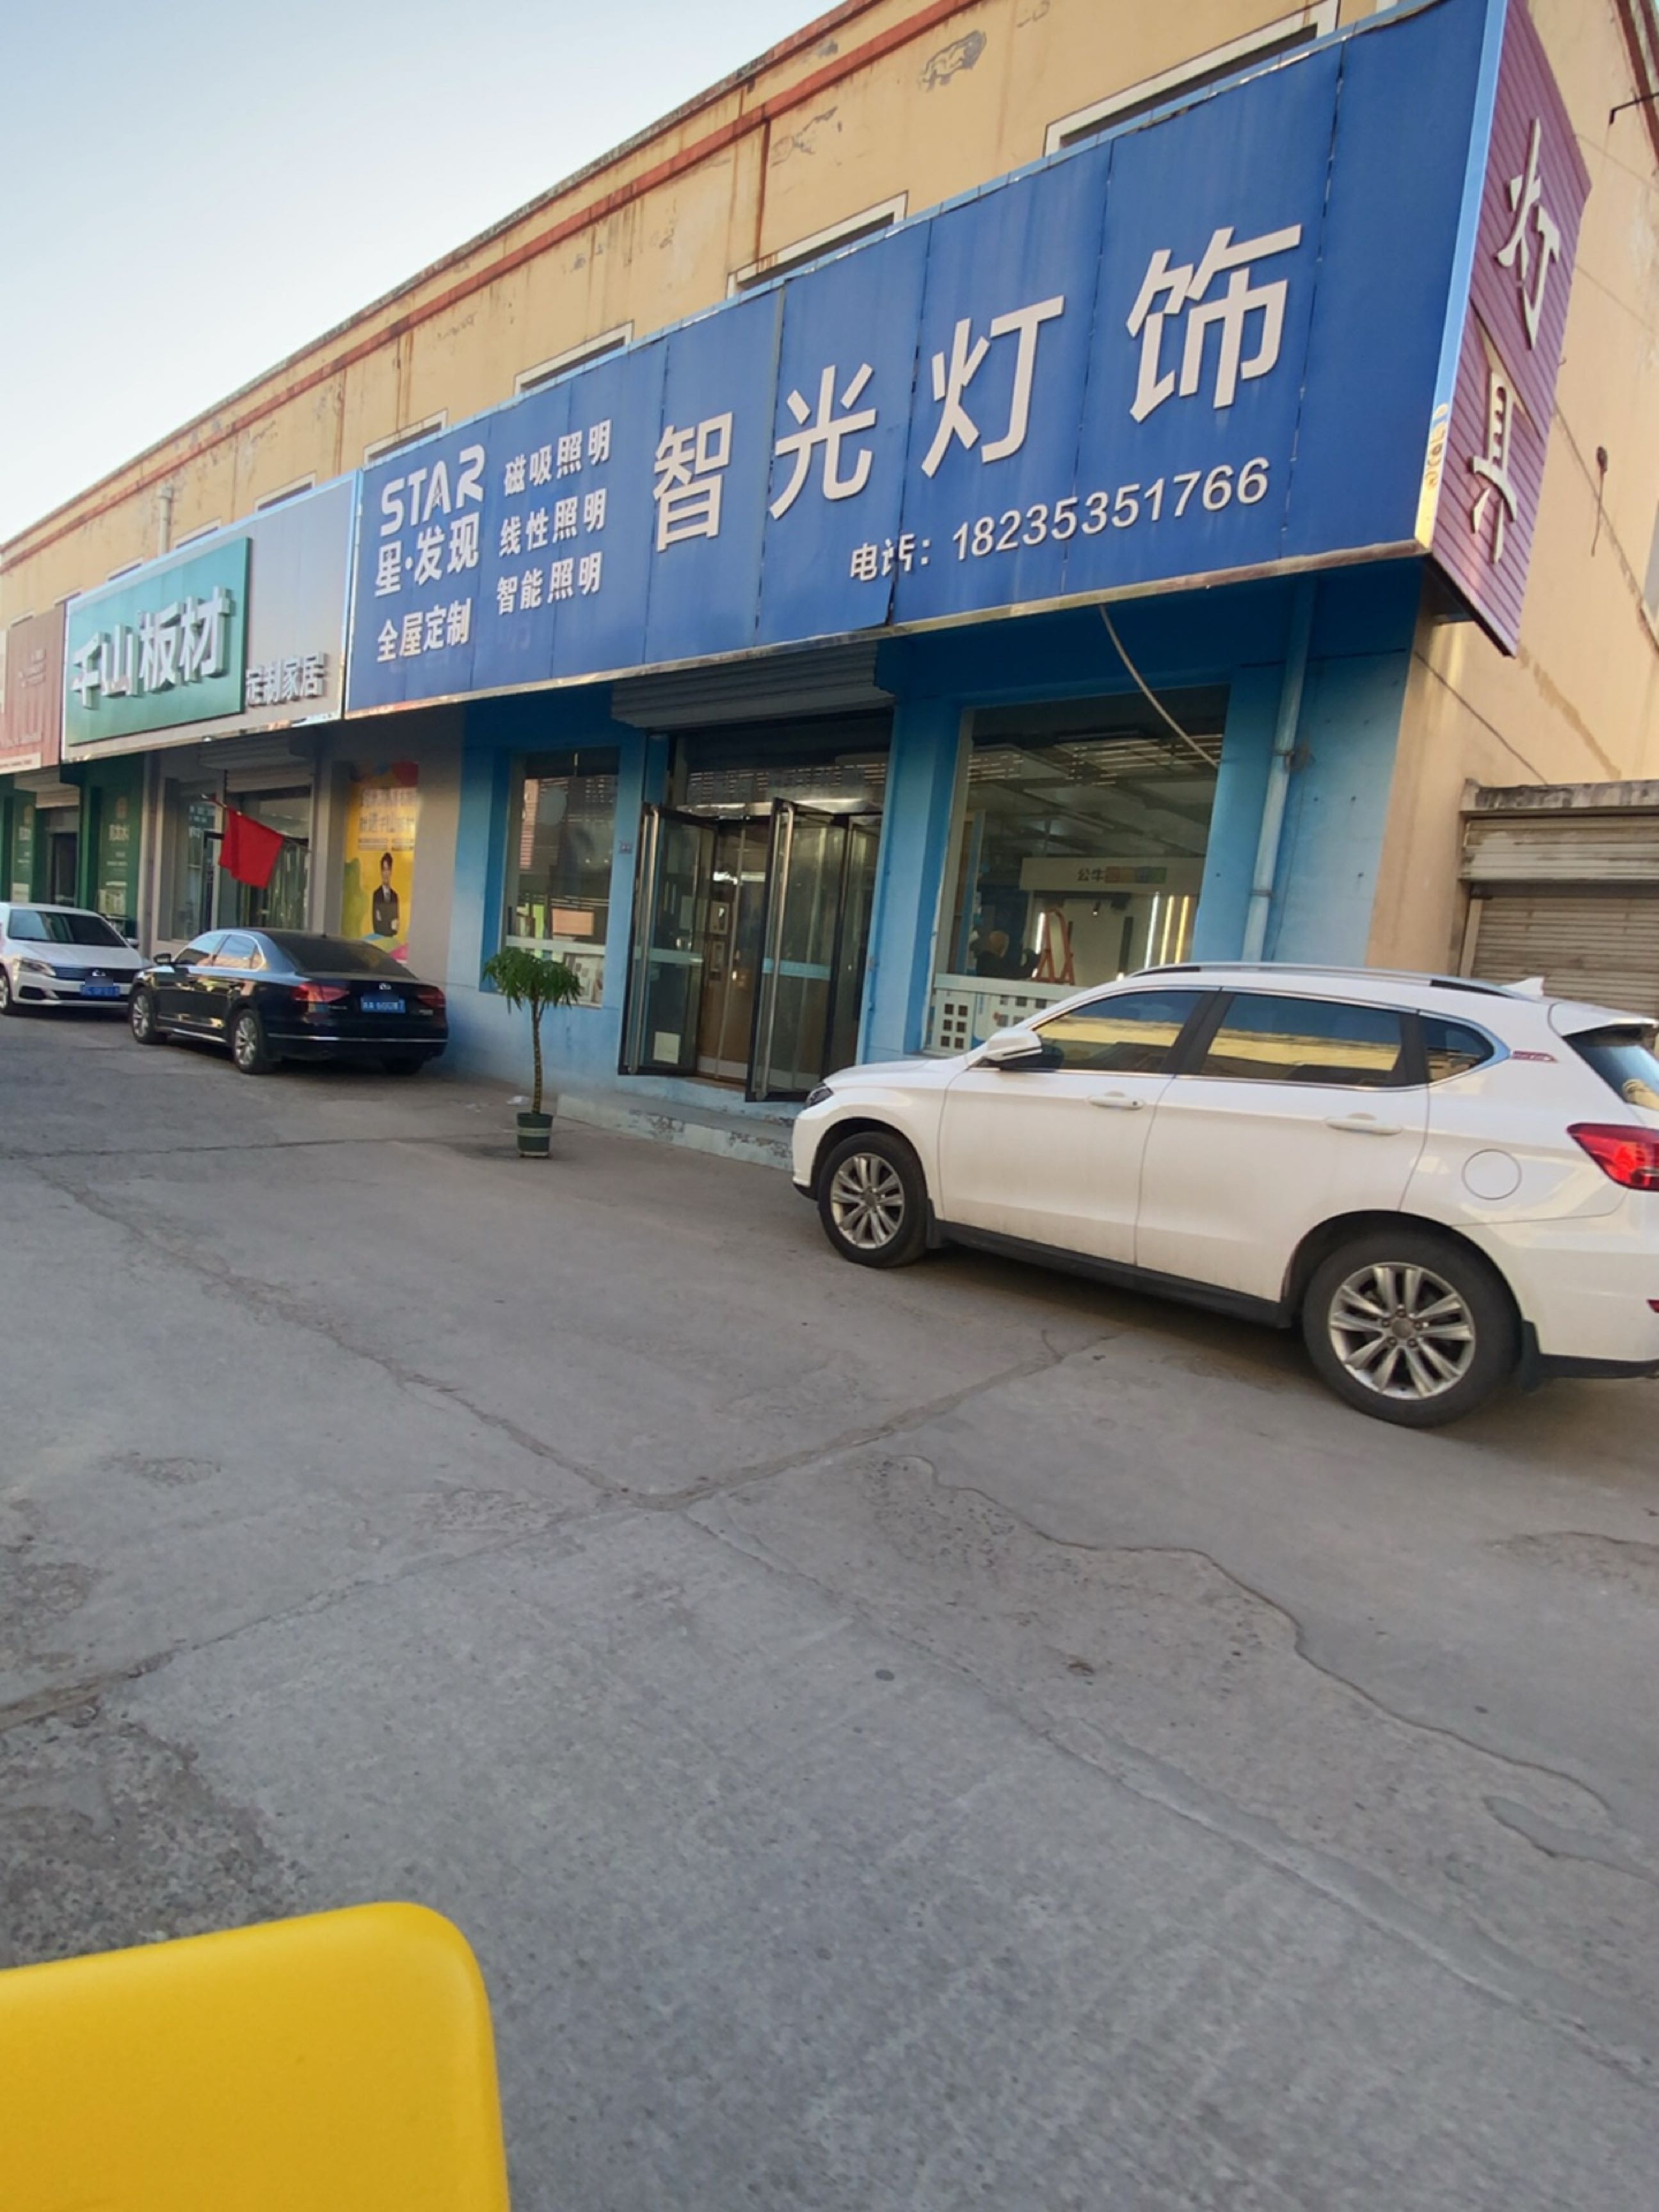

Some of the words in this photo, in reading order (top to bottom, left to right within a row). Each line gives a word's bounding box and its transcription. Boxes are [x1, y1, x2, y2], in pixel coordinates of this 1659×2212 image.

[652, 223, 1302, 553] 智光灯饰
[380, 444, 486, 536] STAR
[503, 419, 613, 497] 磁吸照明
[498, 488, 608, 558] 线性照明
[951, 456, 1270, 562] 18235351766
[496, 551, 603, 615] 智能照明
[376, 597, 473, 663] 全屋定制
